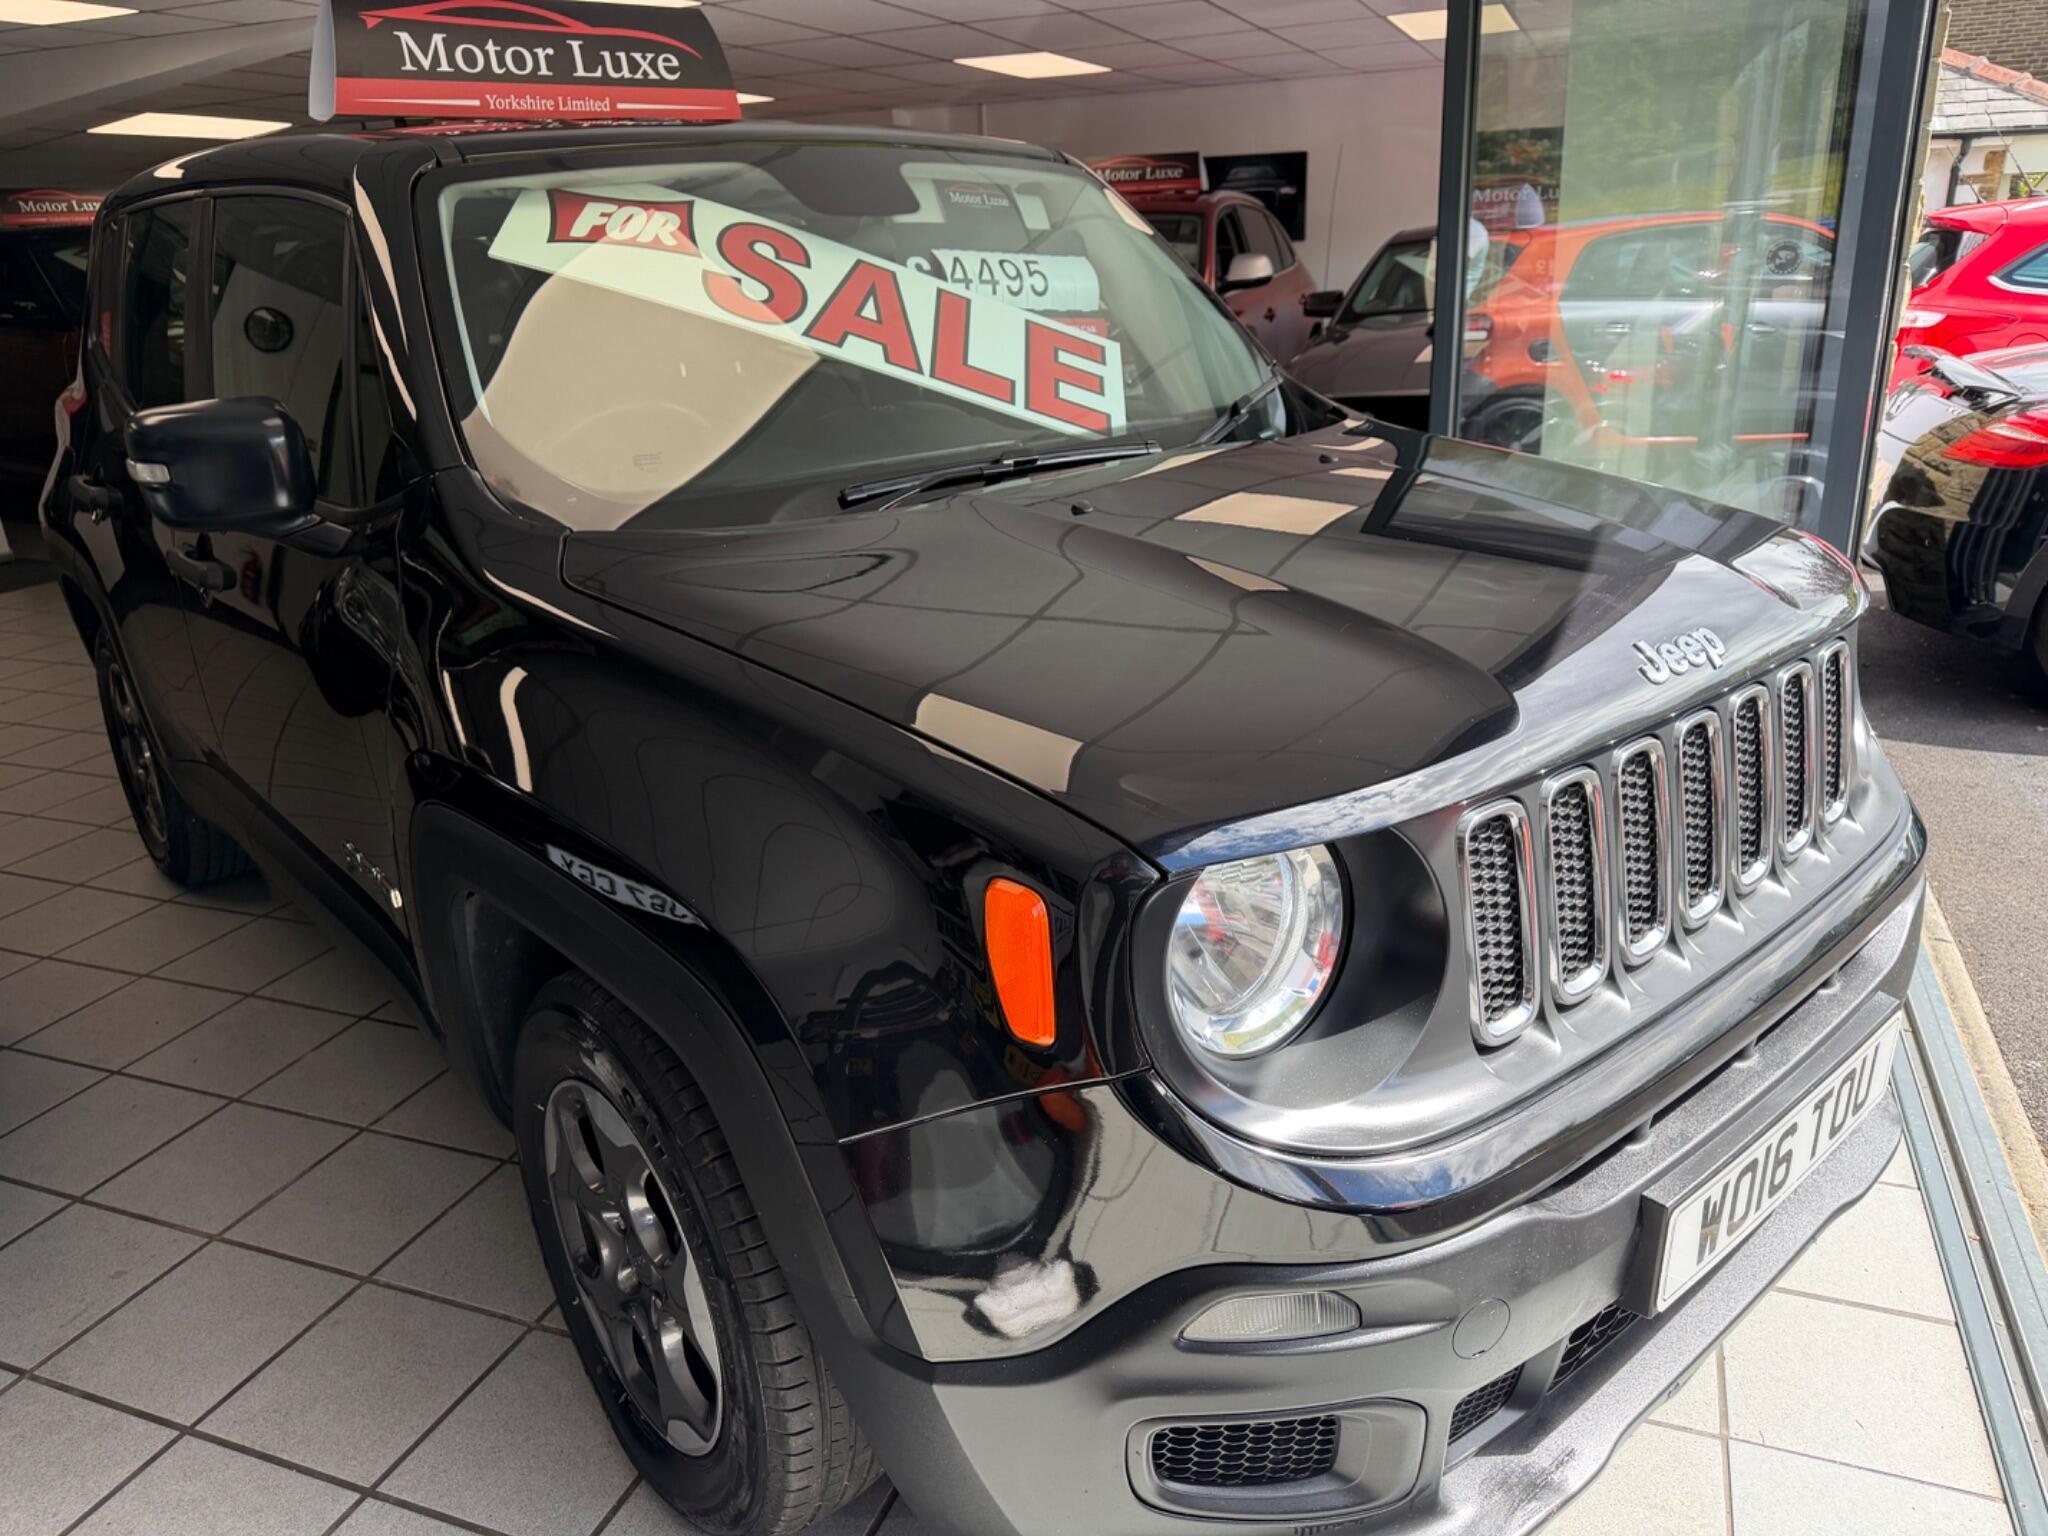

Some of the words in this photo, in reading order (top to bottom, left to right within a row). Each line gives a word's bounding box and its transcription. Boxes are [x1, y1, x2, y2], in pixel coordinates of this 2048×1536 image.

[393, 31, 553, 76] Motor
[566, 40, 681, 80] Luxe
[485, 94, 554, 111] Yorkshire
[558, 96, 611, 112] Limited
[1145, 167, 1183, 180] Luxe
[17, 200, 68, 213] Motor
[569, 202, 681, 246] FOR
[702, 222, 1111, 435] SALE
[1632, 627, 1726, 685] Jeep
[1809, 1042, 1881, 1161] TOU
